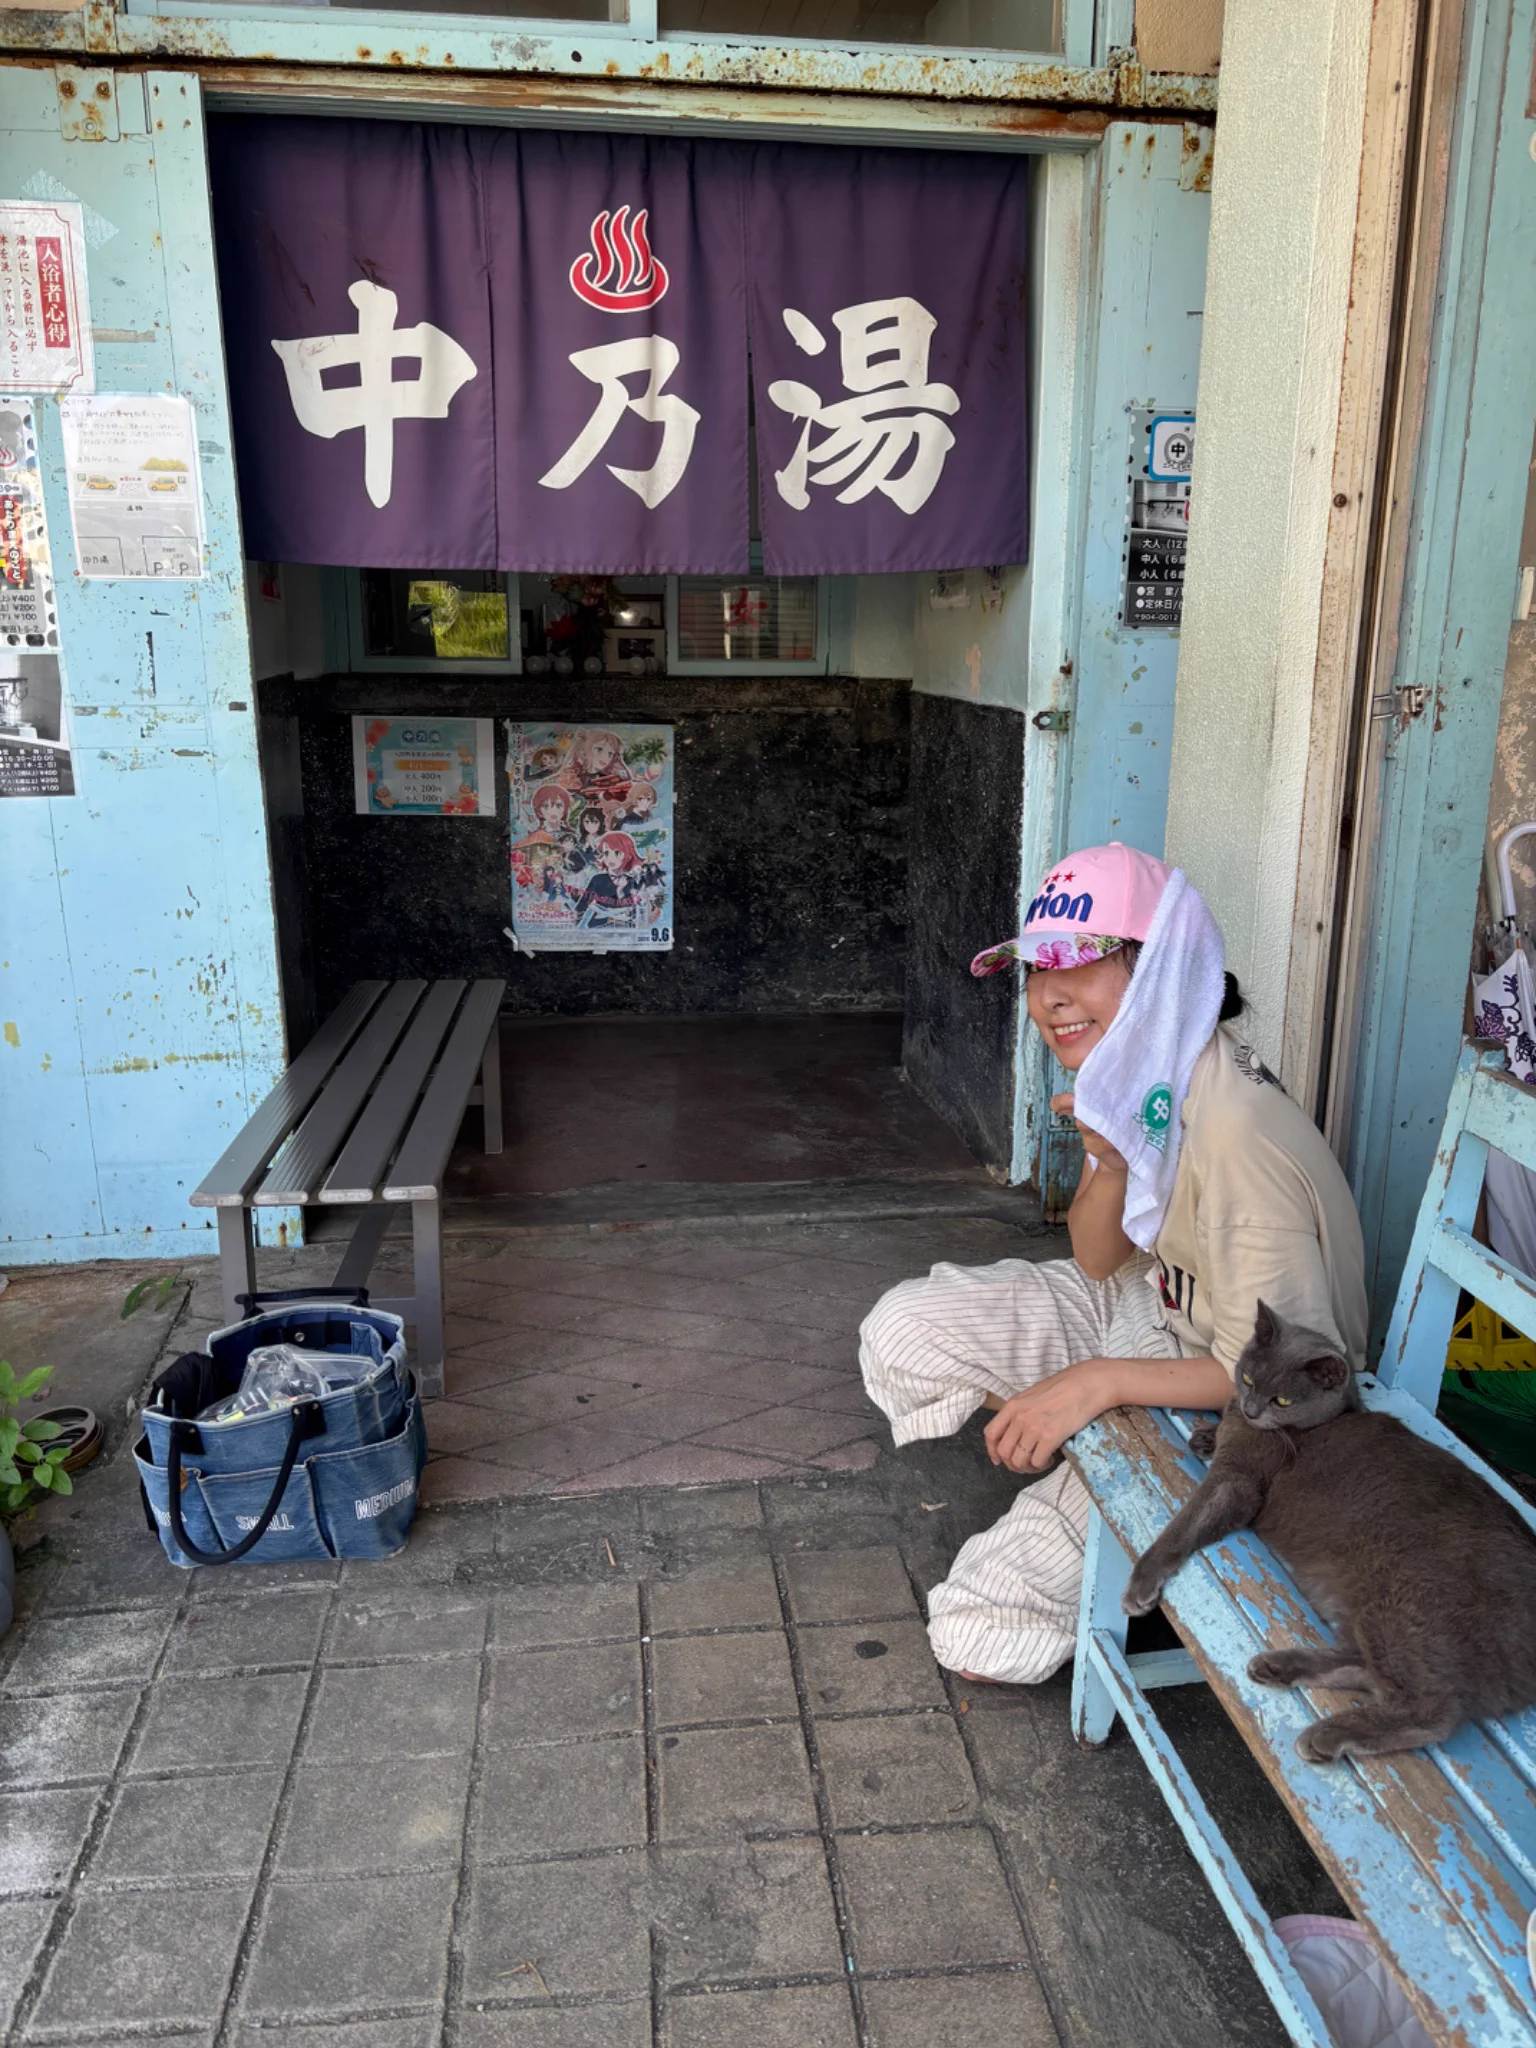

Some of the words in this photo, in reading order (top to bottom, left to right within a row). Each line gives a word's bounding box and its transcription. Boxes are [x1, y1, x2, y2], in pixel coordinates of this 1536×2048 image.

[41, 243, 67, 342] 入浴者心得
[271, 280, 961, 515] 中乃湯
[1170, 442, 1186, 459] 中
[1142, 539, 1161, 549] 大人
[1141, 554, 1160, 564] 中人
[1140, 569, 1159, 579] 小人
[723, 587, 768, 629] 女
[1024, 883, 1093, 927] rion
[651, 927, 669, 942] 9.6
[354, 1476, 415, 1520] MEDIUM
